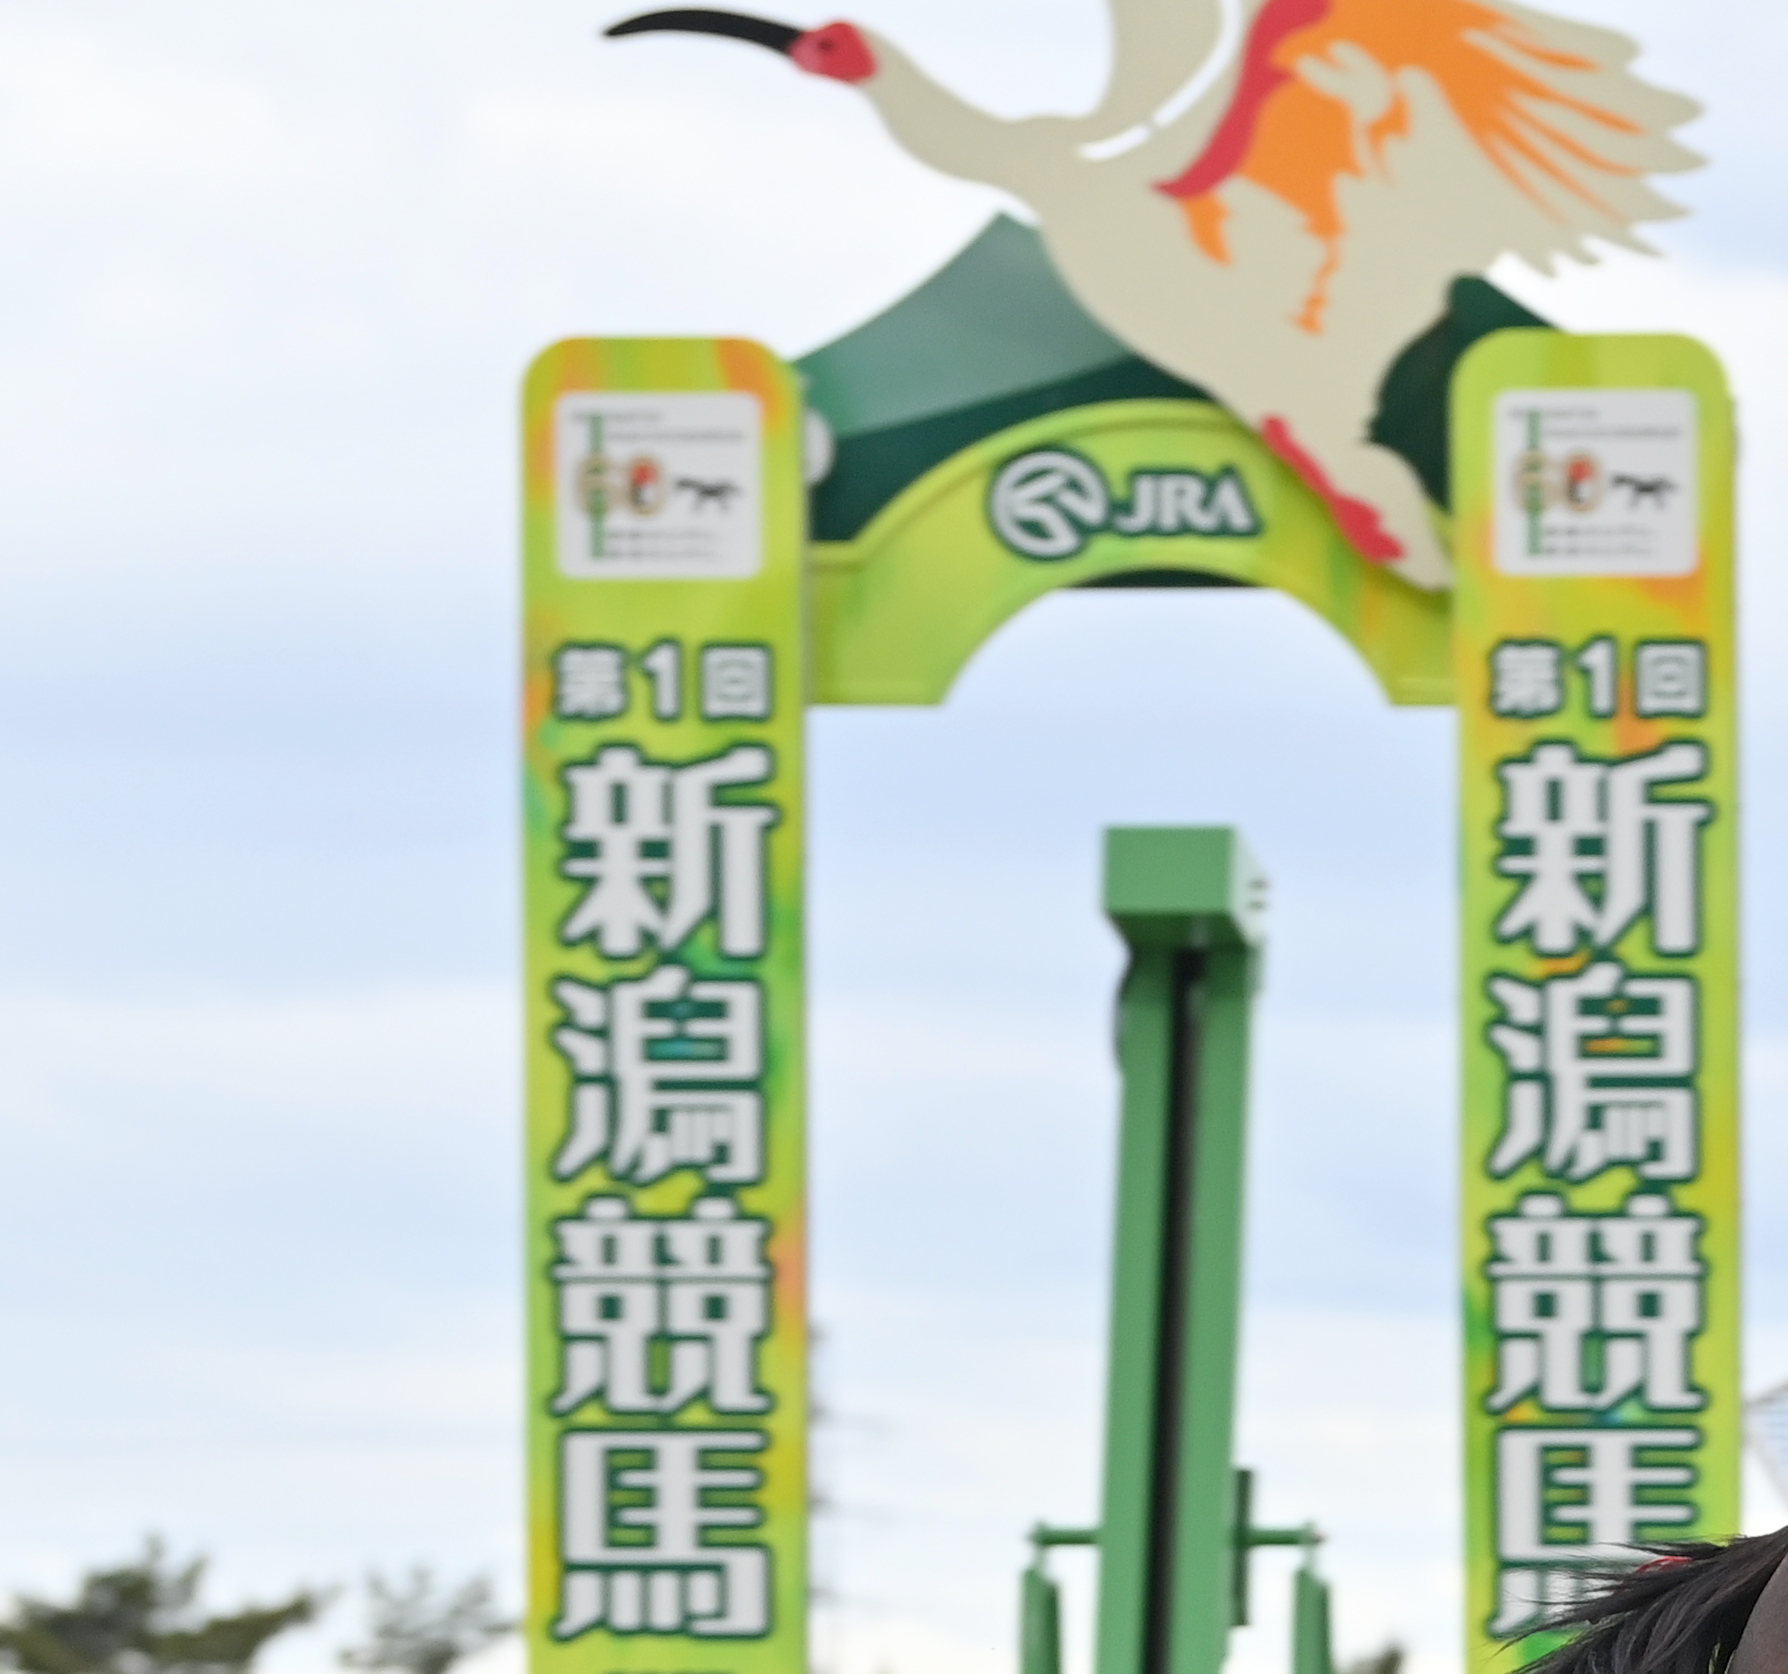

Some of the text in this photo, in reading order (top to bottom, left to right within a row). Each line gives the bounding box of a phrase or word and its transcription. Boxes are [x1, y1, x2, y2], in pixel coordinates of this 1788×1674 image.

[1116, 472, 1252, 531] JRA
[556, 643, 770, 718] 第1回
[1492, 635, 1704, 715] 第1回
[554, 745, 774, 1635] 新潟競馬
